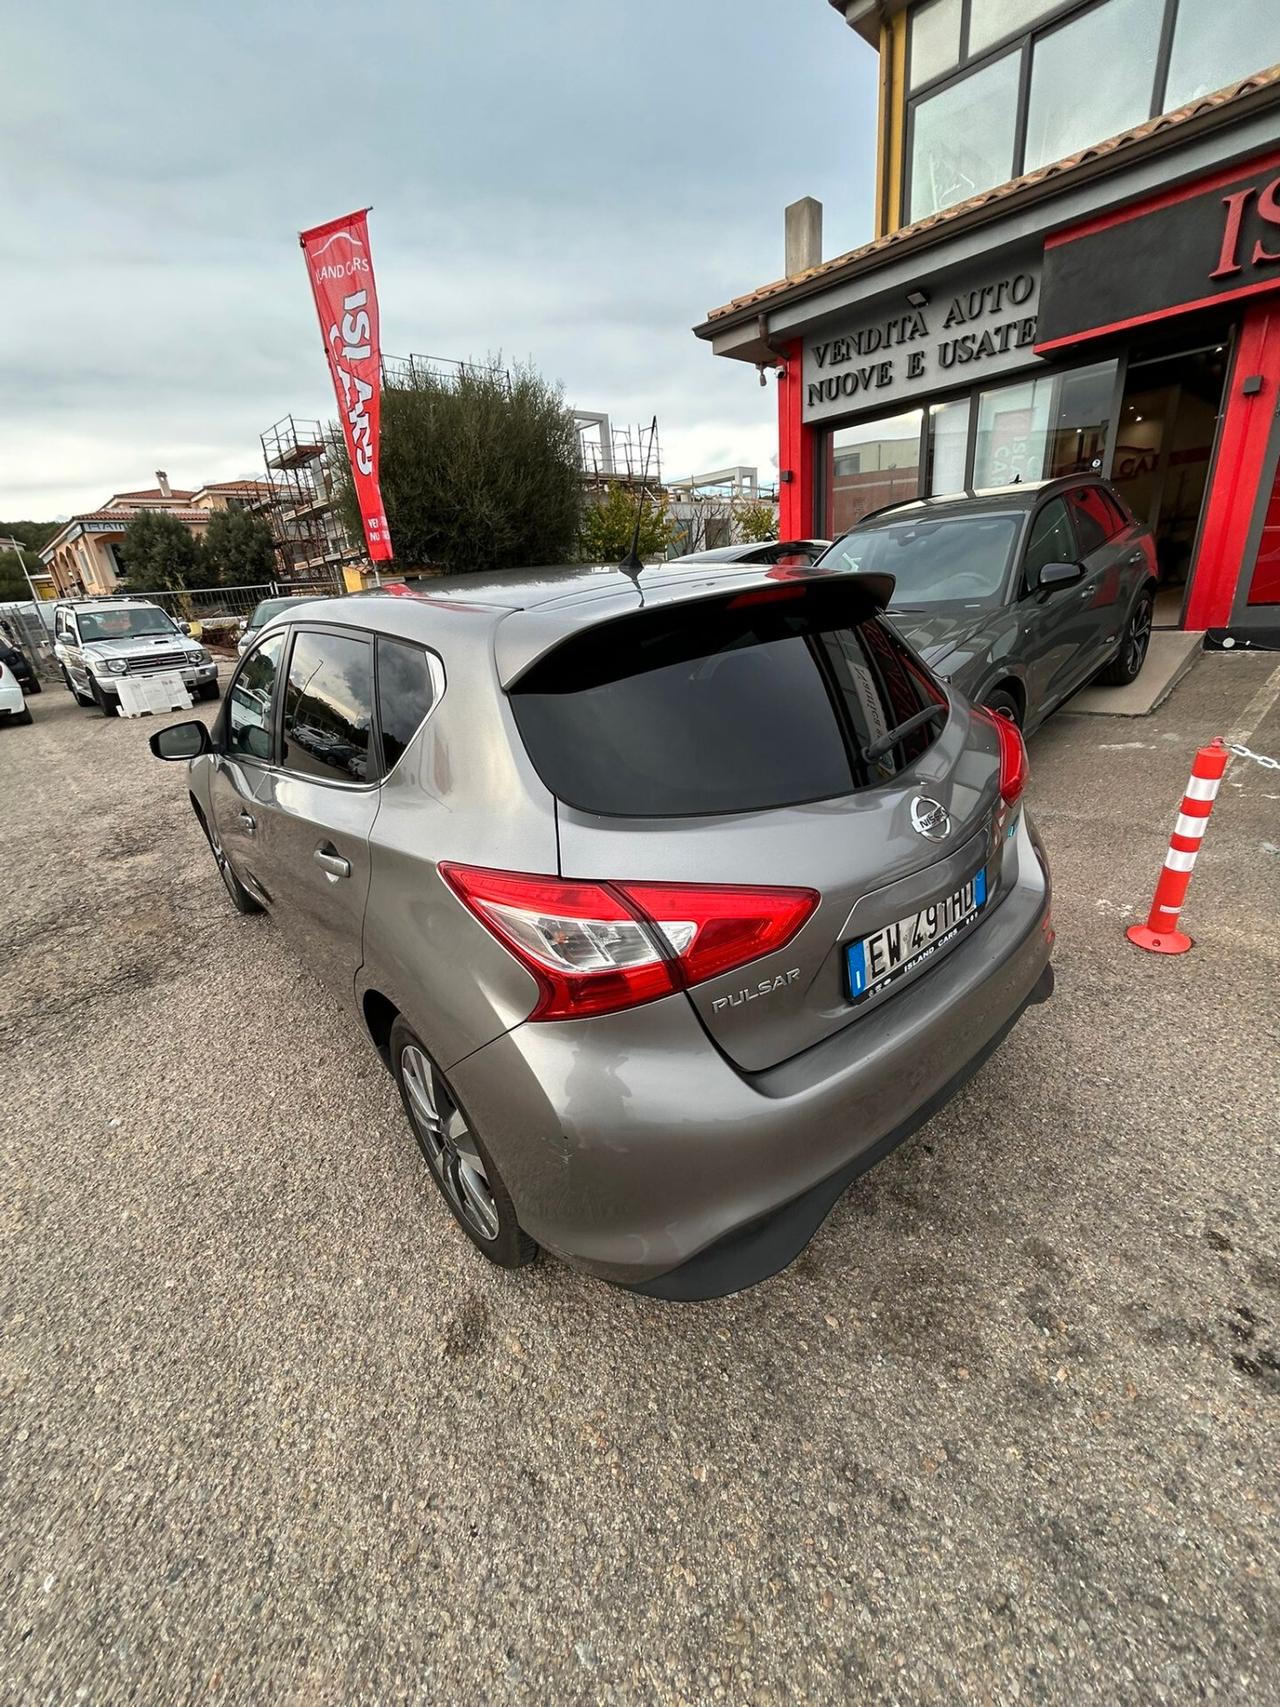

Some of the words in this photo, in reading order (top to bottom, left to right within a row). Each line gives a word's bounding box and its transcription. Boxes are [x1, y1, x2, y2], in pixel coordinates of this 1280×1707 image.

[943, 273, 1034, 328] AUTO
[807, 360, 893, 406] NUOVE
[906, 350, 925, 379] E
[937, 315, 1037, 369] USATE
[869, 923, 900, 979] EW
[904, 946, 935, 973] ISLAND
[938, 928, 959, 947] CARS
[711, 967, 801, 1014] PULSAR
